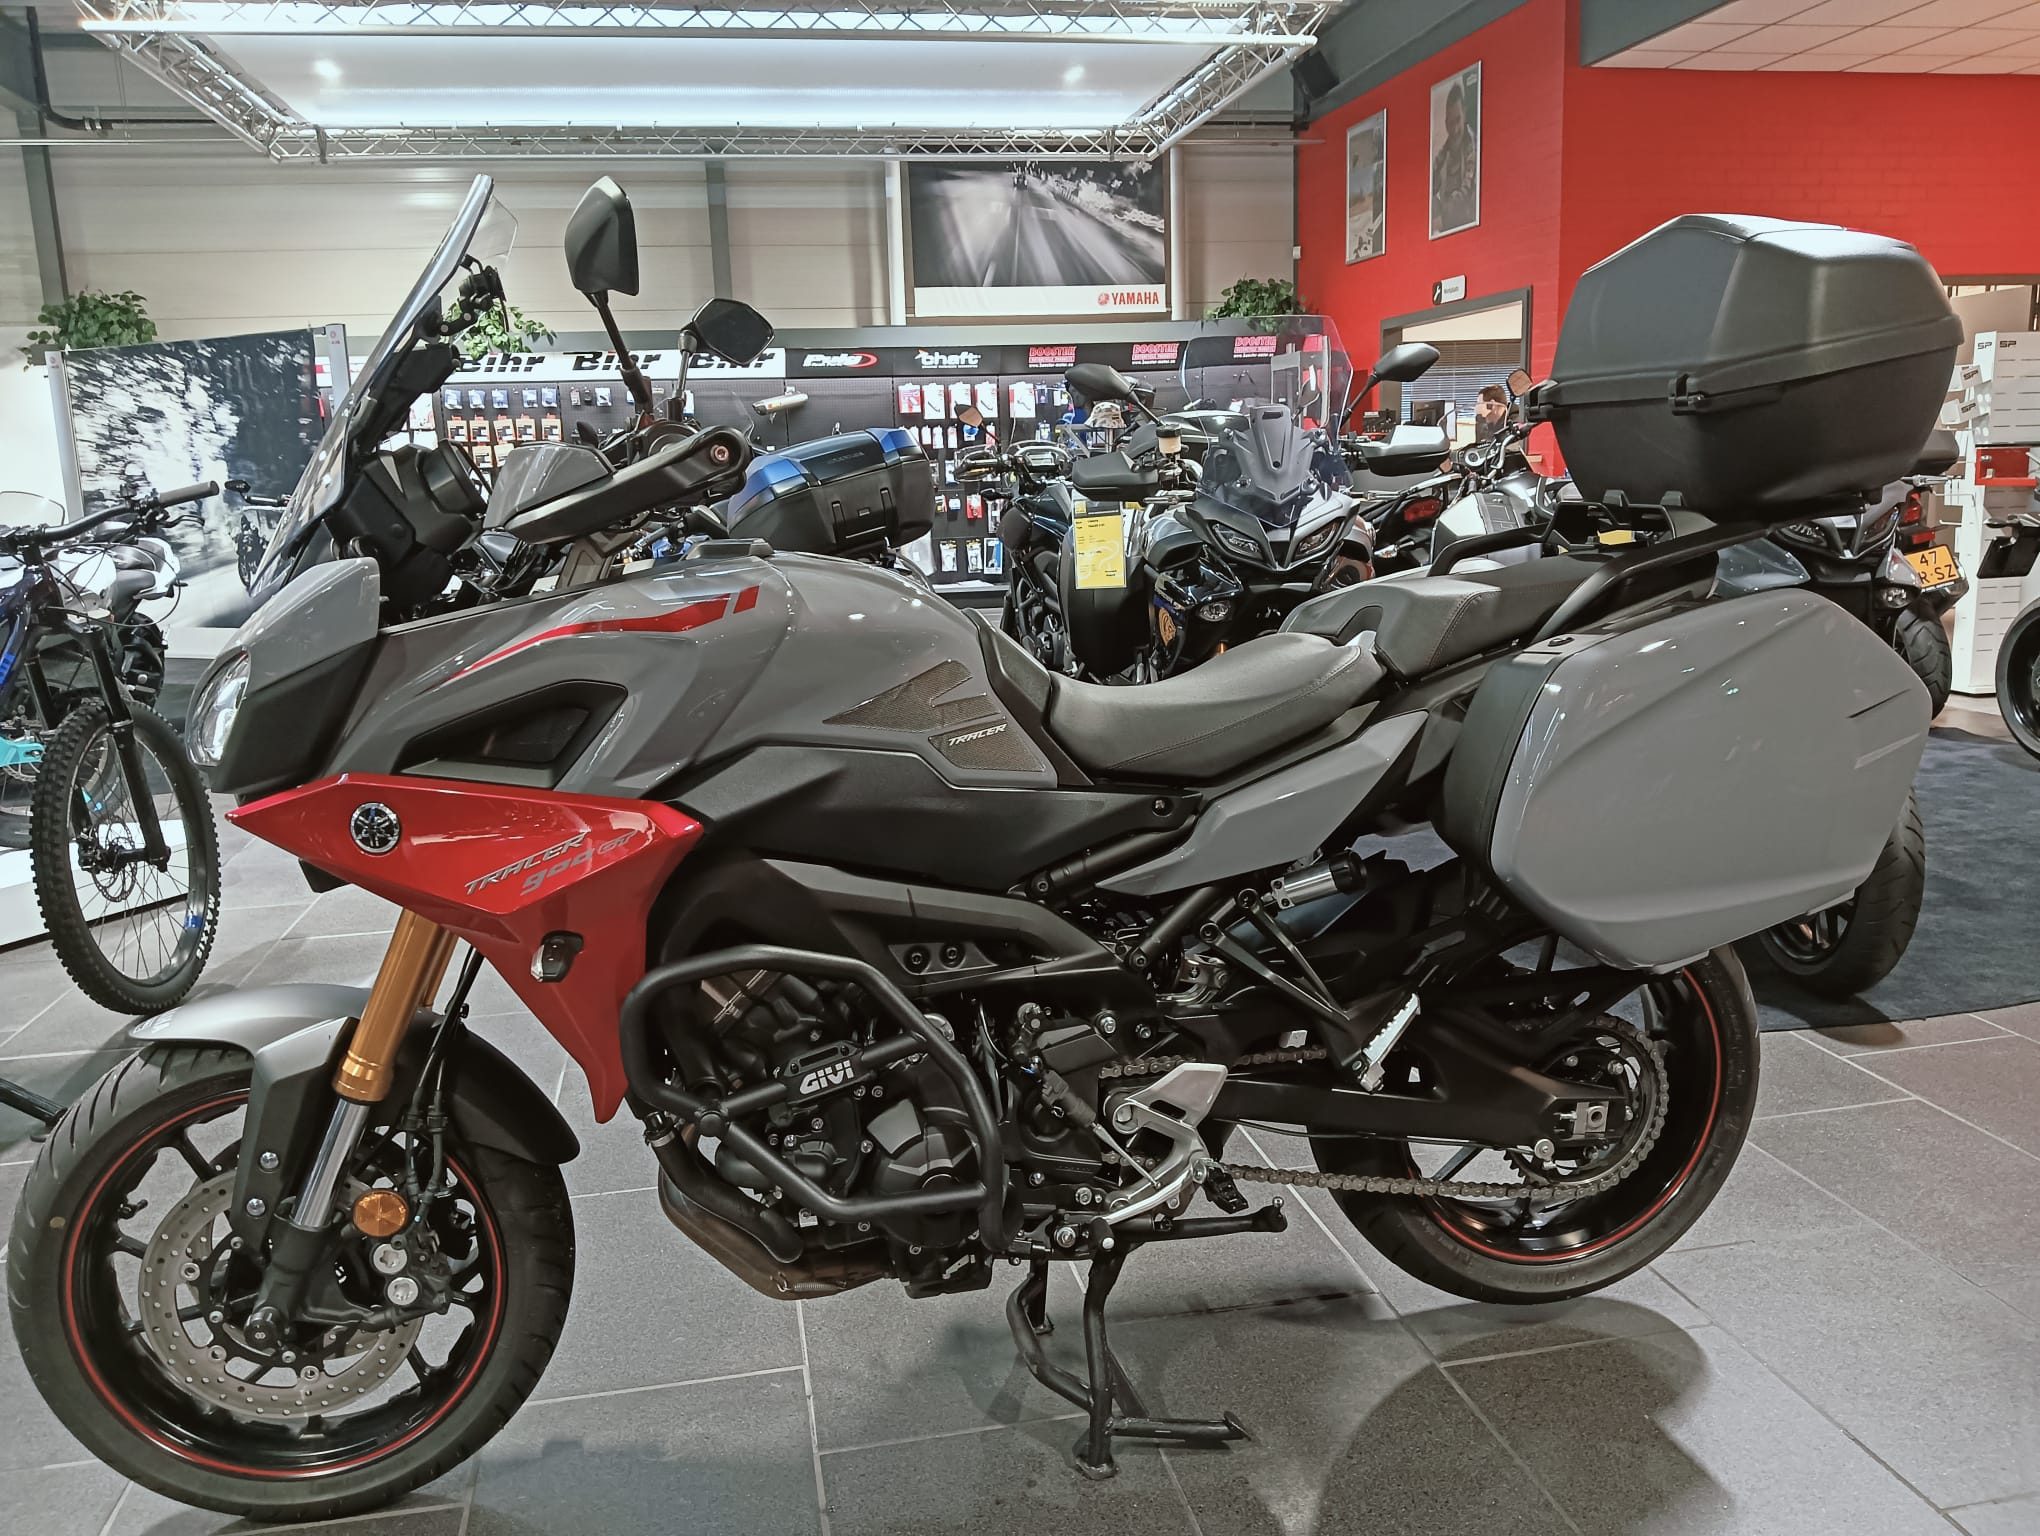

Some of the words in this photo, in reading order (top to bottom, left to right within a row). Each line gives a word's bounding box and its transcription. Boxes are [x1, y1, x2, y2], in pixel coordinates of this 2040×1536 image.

[1112, 292, 1159, 305] YAMAHA
[1963, 369, 1978, 380] SP
[1961, 403, 1976, 413] SP
[1919, 551, 1937, 566] 47
[1917, 563, 1956, 584] R-SZ
[947, 723, 1008, 746] TRACER
[464, 831, 588, 895] TRACER
[520, 847, 595, 896] 900
[597, 829, 639, 855] GT
[196, 893, 215, 959] MAXXIS
[800, 1060, 854, 1094] GIVI
